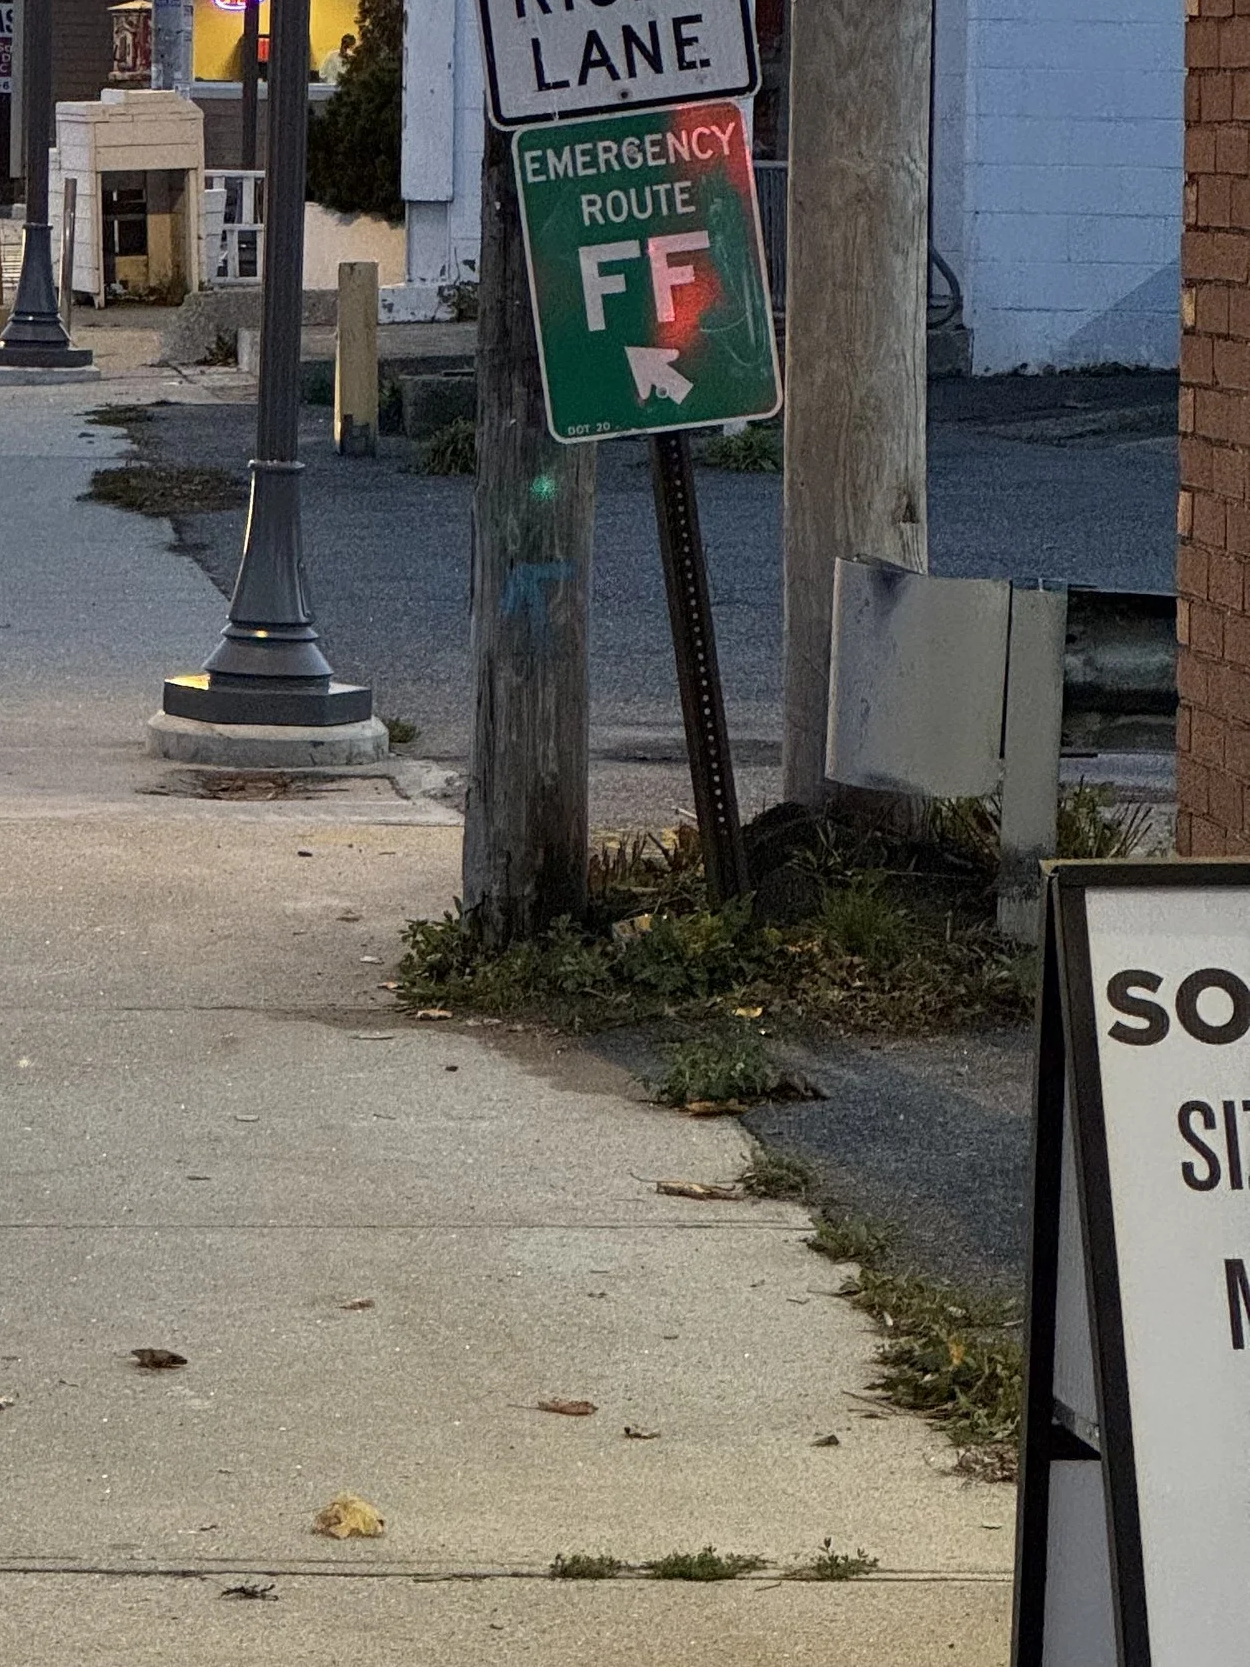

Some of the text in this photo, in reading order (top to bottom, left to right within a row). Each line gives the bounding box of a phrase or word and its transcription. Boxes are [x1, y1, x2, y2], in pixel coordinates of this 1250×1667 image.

[531, 14, 711, 92] LANE
[524, 122, 735, 184] EMERGENCY
[581, 181, 696, 227] ROUTE
[578, 230, 710, 332] FF
[1177, 1100, 1250, 1192] SI
